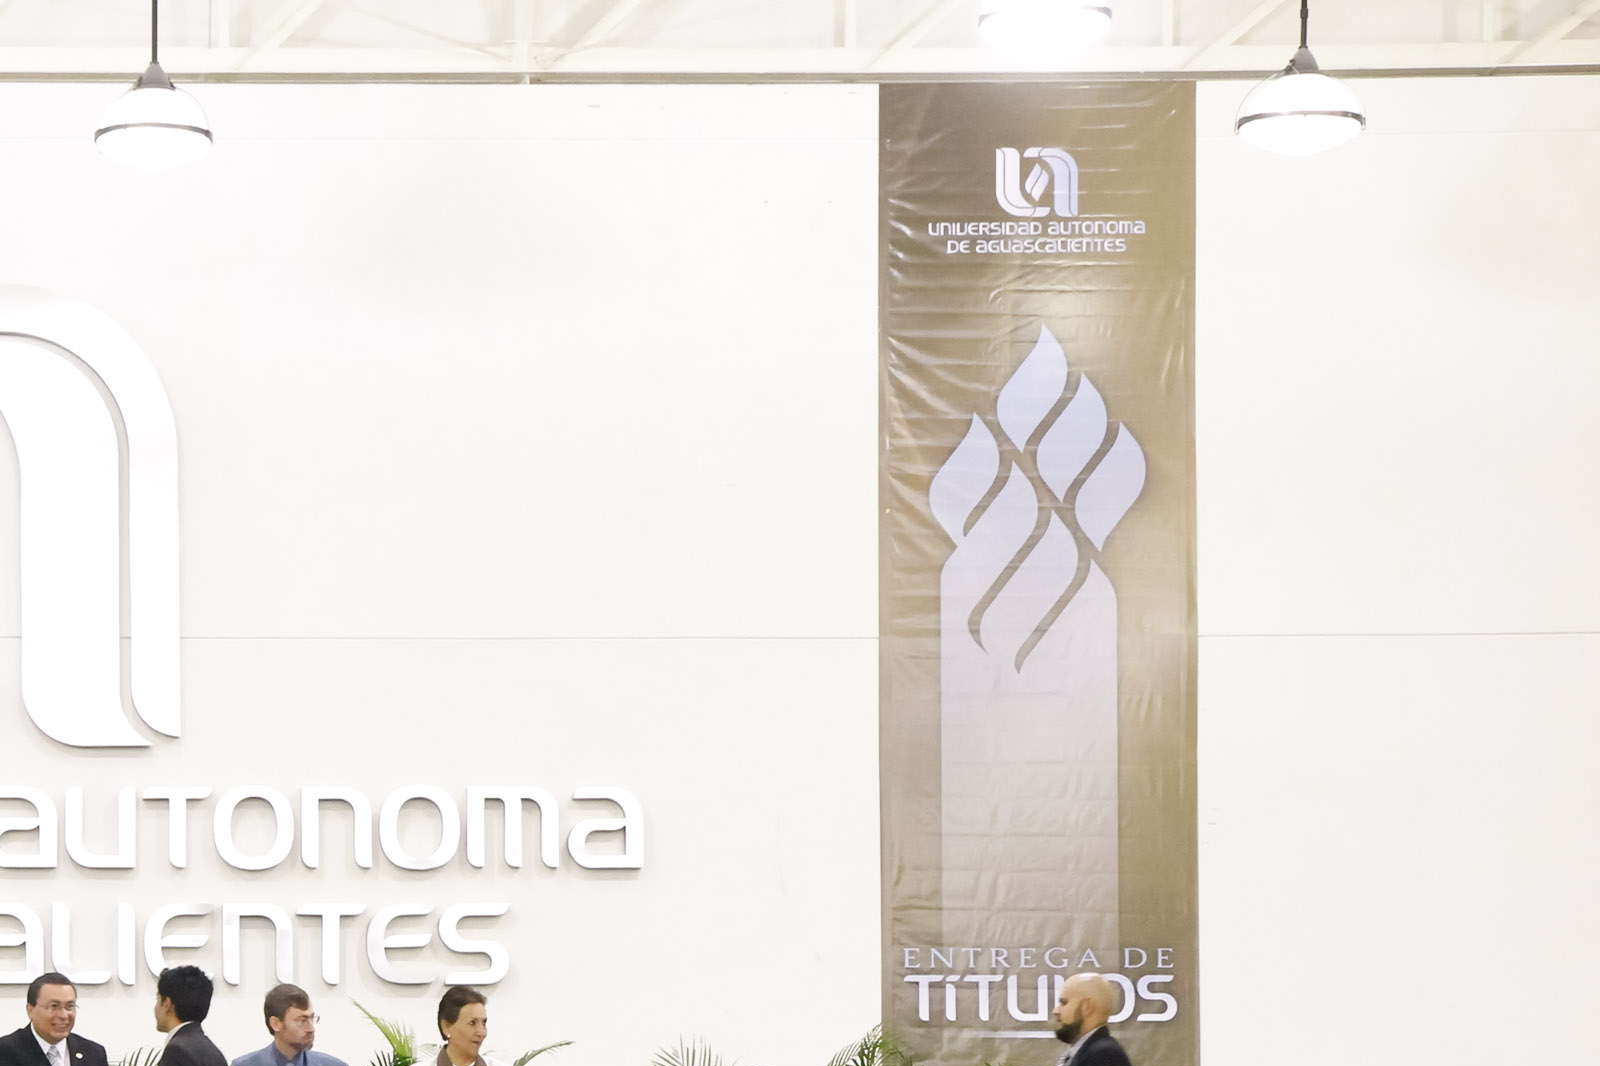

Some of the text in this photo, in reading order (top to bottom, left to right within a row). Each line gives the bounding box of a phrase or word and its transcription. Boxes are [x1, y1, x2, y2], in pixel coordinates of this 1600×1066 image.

[946, 239, 970, 254] DE
[903, 947, 1174, 968] ENTREGA DE
[903, 973, 1179, 1023] TÍTUOS
